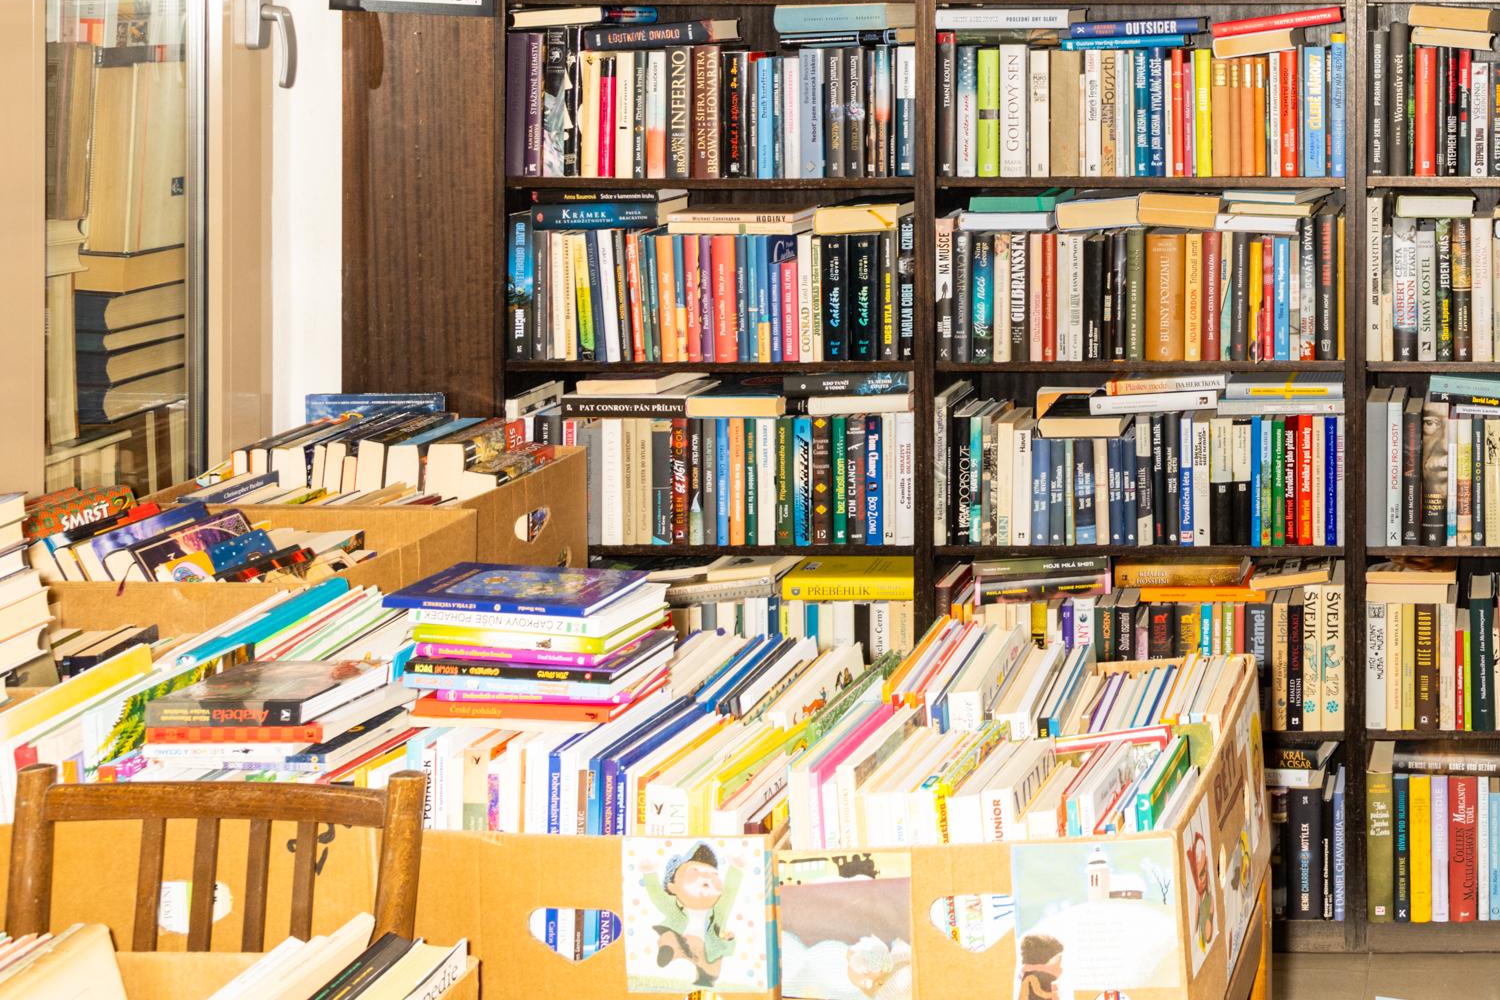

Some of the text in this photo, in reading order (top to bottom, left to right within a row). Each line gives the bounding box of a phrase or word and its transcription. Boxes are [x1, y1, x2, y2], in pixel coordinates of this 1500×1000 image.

[1126, 21, 1177, 35] OUTSIDER
[673, 50, 686, 129] INFERNO
[562, 209, 607, 220] KRÁMEK
[939, 233, 949, 274] NA MUŠCE
[1013, 234, 1024, 321] GULBRANSSEN
[1422, 257, 1430, 296] KOSTEL
[801, 308, 810, 352] CONRAD
[902, 284, 911, 338] HARLAN COBEN
[634, 404, 650, 412] PÁN
[653, 403, 684, 412] PŘÍLIVU
[61, 501, 110, 530] SMRŠŤ
[1304, 590, 1317, 640] ŠVEJK
[1326, 590, 1338, 640] ŠVEJK
[212, 708, 269, 722] Arabela
[1283, 752, 1306, 761] KRÁL
